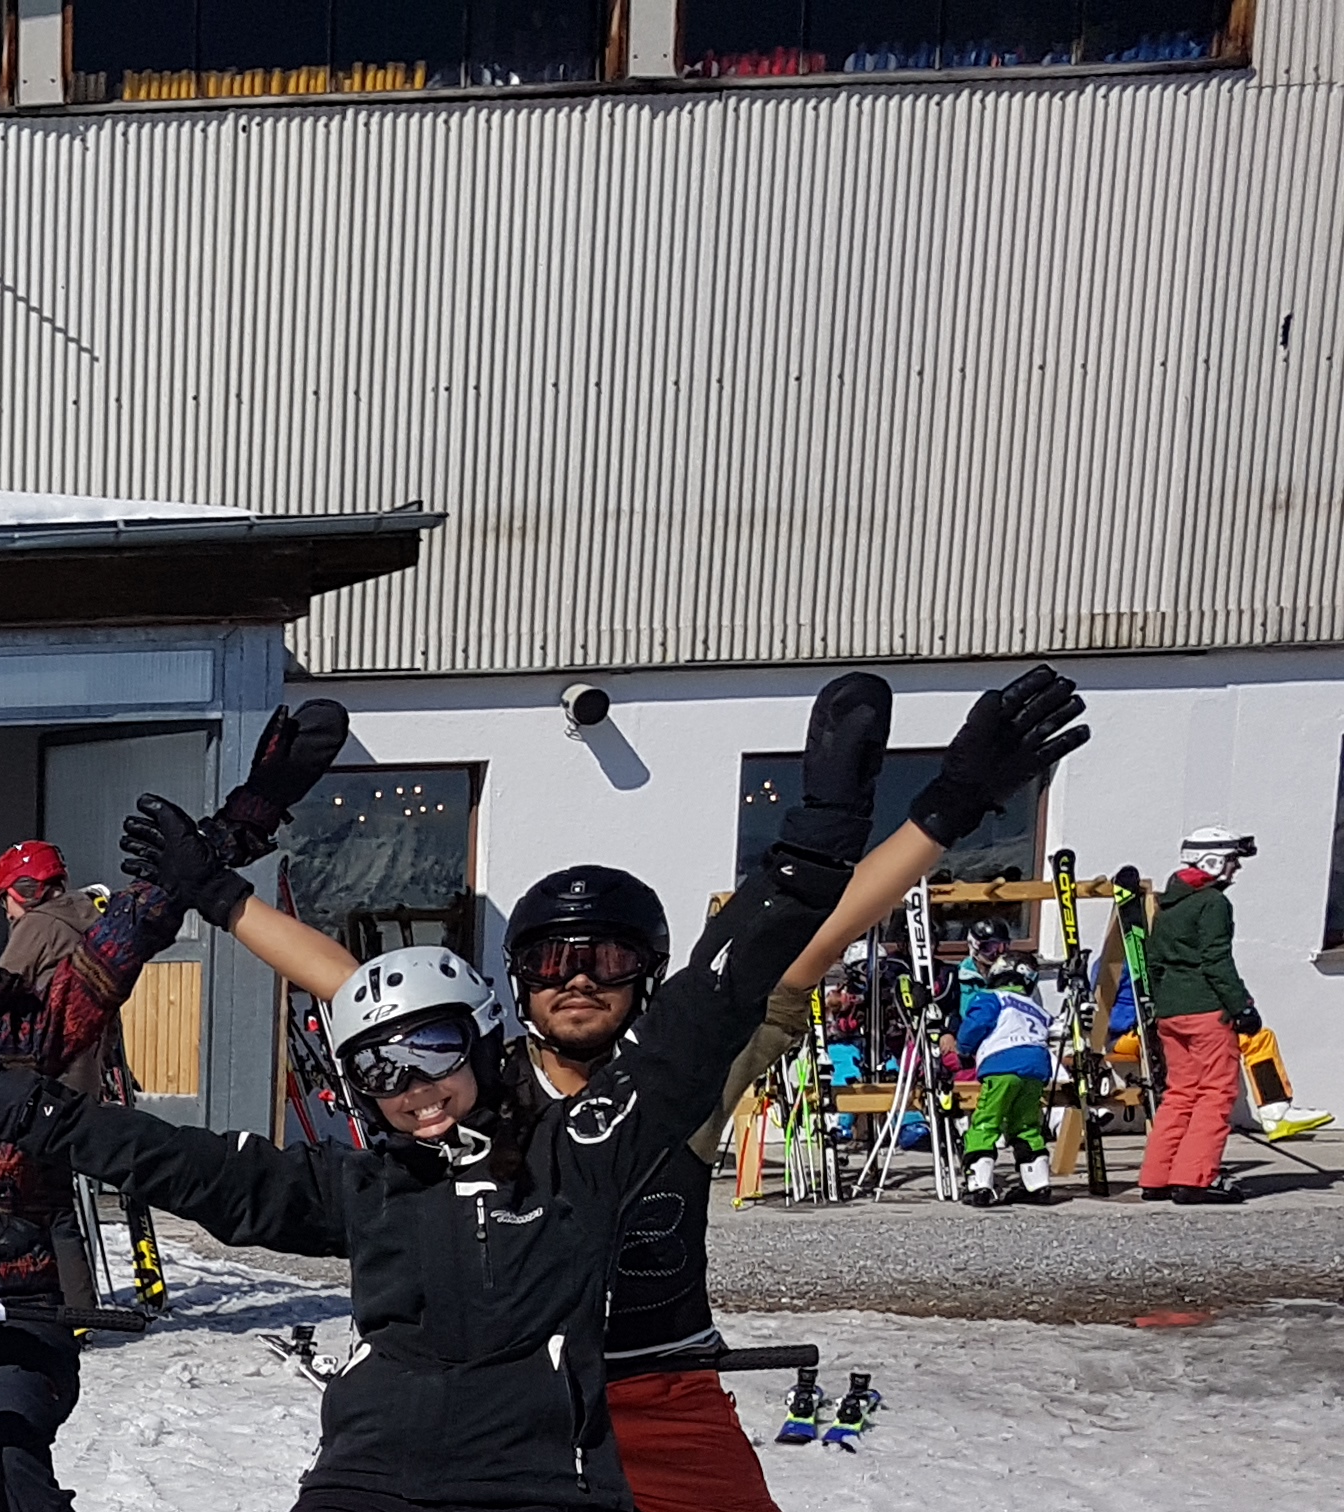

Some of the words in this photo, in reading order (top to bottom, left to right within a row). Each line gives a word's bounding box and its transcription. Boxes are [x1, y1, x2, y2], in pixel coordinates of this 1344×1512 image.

[911, 891, 928, 961] HEAD
[1059, 873, 1078, 945] HEAD
[811, 987, 823, 1024] HEA
[1026, 1017, 1039, 1035] 2
